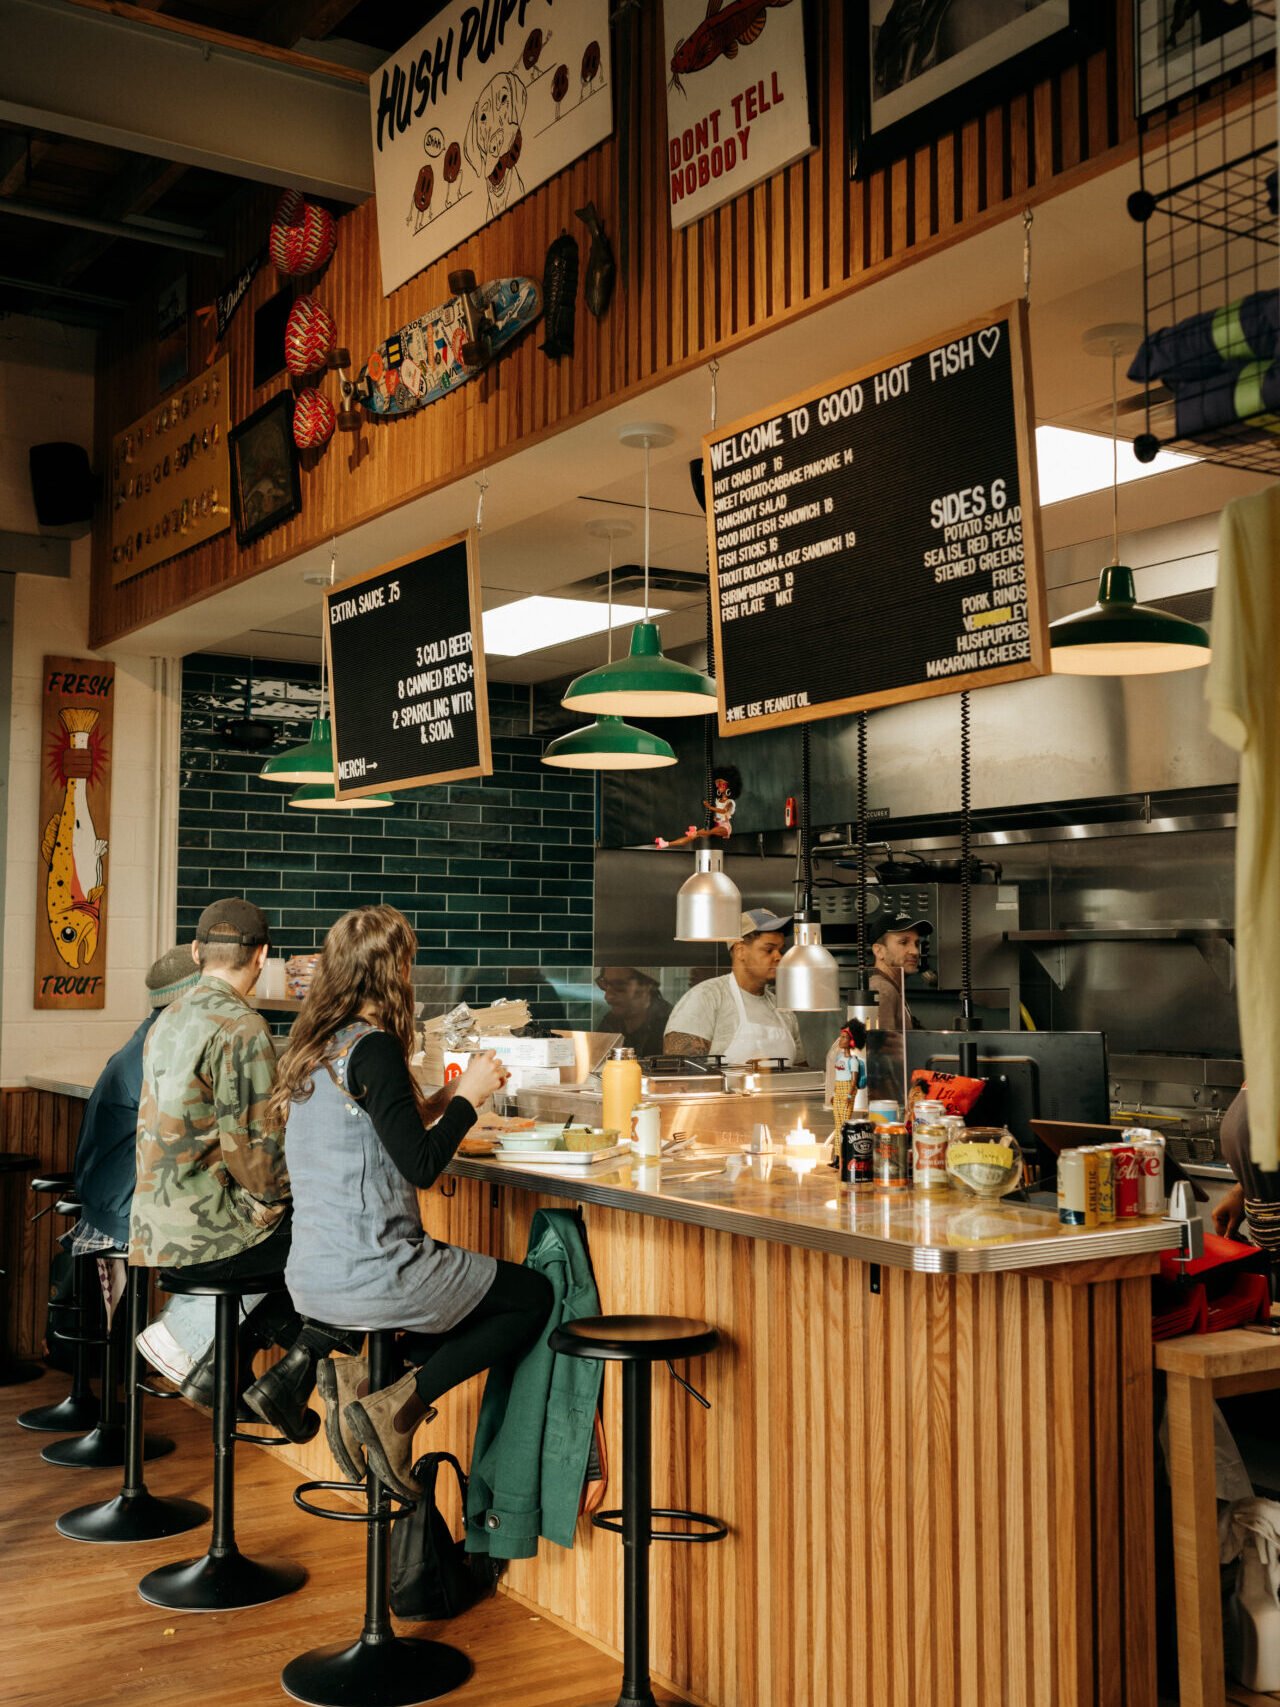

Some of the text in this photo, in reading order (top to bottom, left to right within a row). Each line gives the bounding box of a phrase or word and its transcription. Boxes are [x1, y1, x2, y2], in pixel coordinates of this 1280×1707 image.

[377, 27, 453, 152] HUSH
[670, 71, 784, 171] DONT TELL
[671, 126, 750, 204] NOBODY
[710, 337, 974, 471] WELCOME TO GOOD HOT FISH
[714, 456, 783, 495] HOT CRAB DIP 16
[714, 493, 738, 514] SWEET
[803, 452, 841, 479] PANCAKE
[844, 448, 853, 465] 14
[717, 494, 787, 532] RANCHOVY SALAD
[930, 479, 1006, 529] SIDES 6
[717, 497, 833, 550] GOOD HOT FISH SANDWICH 18
[944, 506, 1022, 543] POTATO SALAD
[718, 567, 743, 588] TROUT
[743, 557, 778, 580] BOLOGNA
[785, 549, 801, 566] CHZ
[802, 536, 842, 561] SANDWICH
[845, 532, 856, 548] 19
[719, 537, 778, 569] FISH STICKS 16
[924, 525, 1023, 567] SEA ISL RED PEAS
[934, 545, 1025, 583] STEWED GREENS
[721, 572, 794, 606] SHRIMPBURGER 19
[992, 566, 1025, 587] FRIES
[330, 580, 400, 624] EXTRA SAUCE .75
[721, 588, 794, 622] FISH PLATE MKT
[962, 584, 1027, 614] PORK RINDS
[416, 631, 472, 667] 3 COLD BEER
[957, 622, 1029, 652] HUSHPUPPIES
[926, 652, 978, 678] MACARONI
[48, 671, 113, 697] FRESH
[398, 680, 405, 699] 8
[406, 669, 442, 697] CANNED
[392, 691, 473, 729] 2 SPARKLING WTR
[747, 701, 763, 717] USE
[764, 694, 796, 714] PEANUT
[797, 691, 811, 706] OIL
[420, 719, 454, 744] & SODA
[338, 757, 366, 780] MERCH
[40, 975, 101, 998] TROUT
